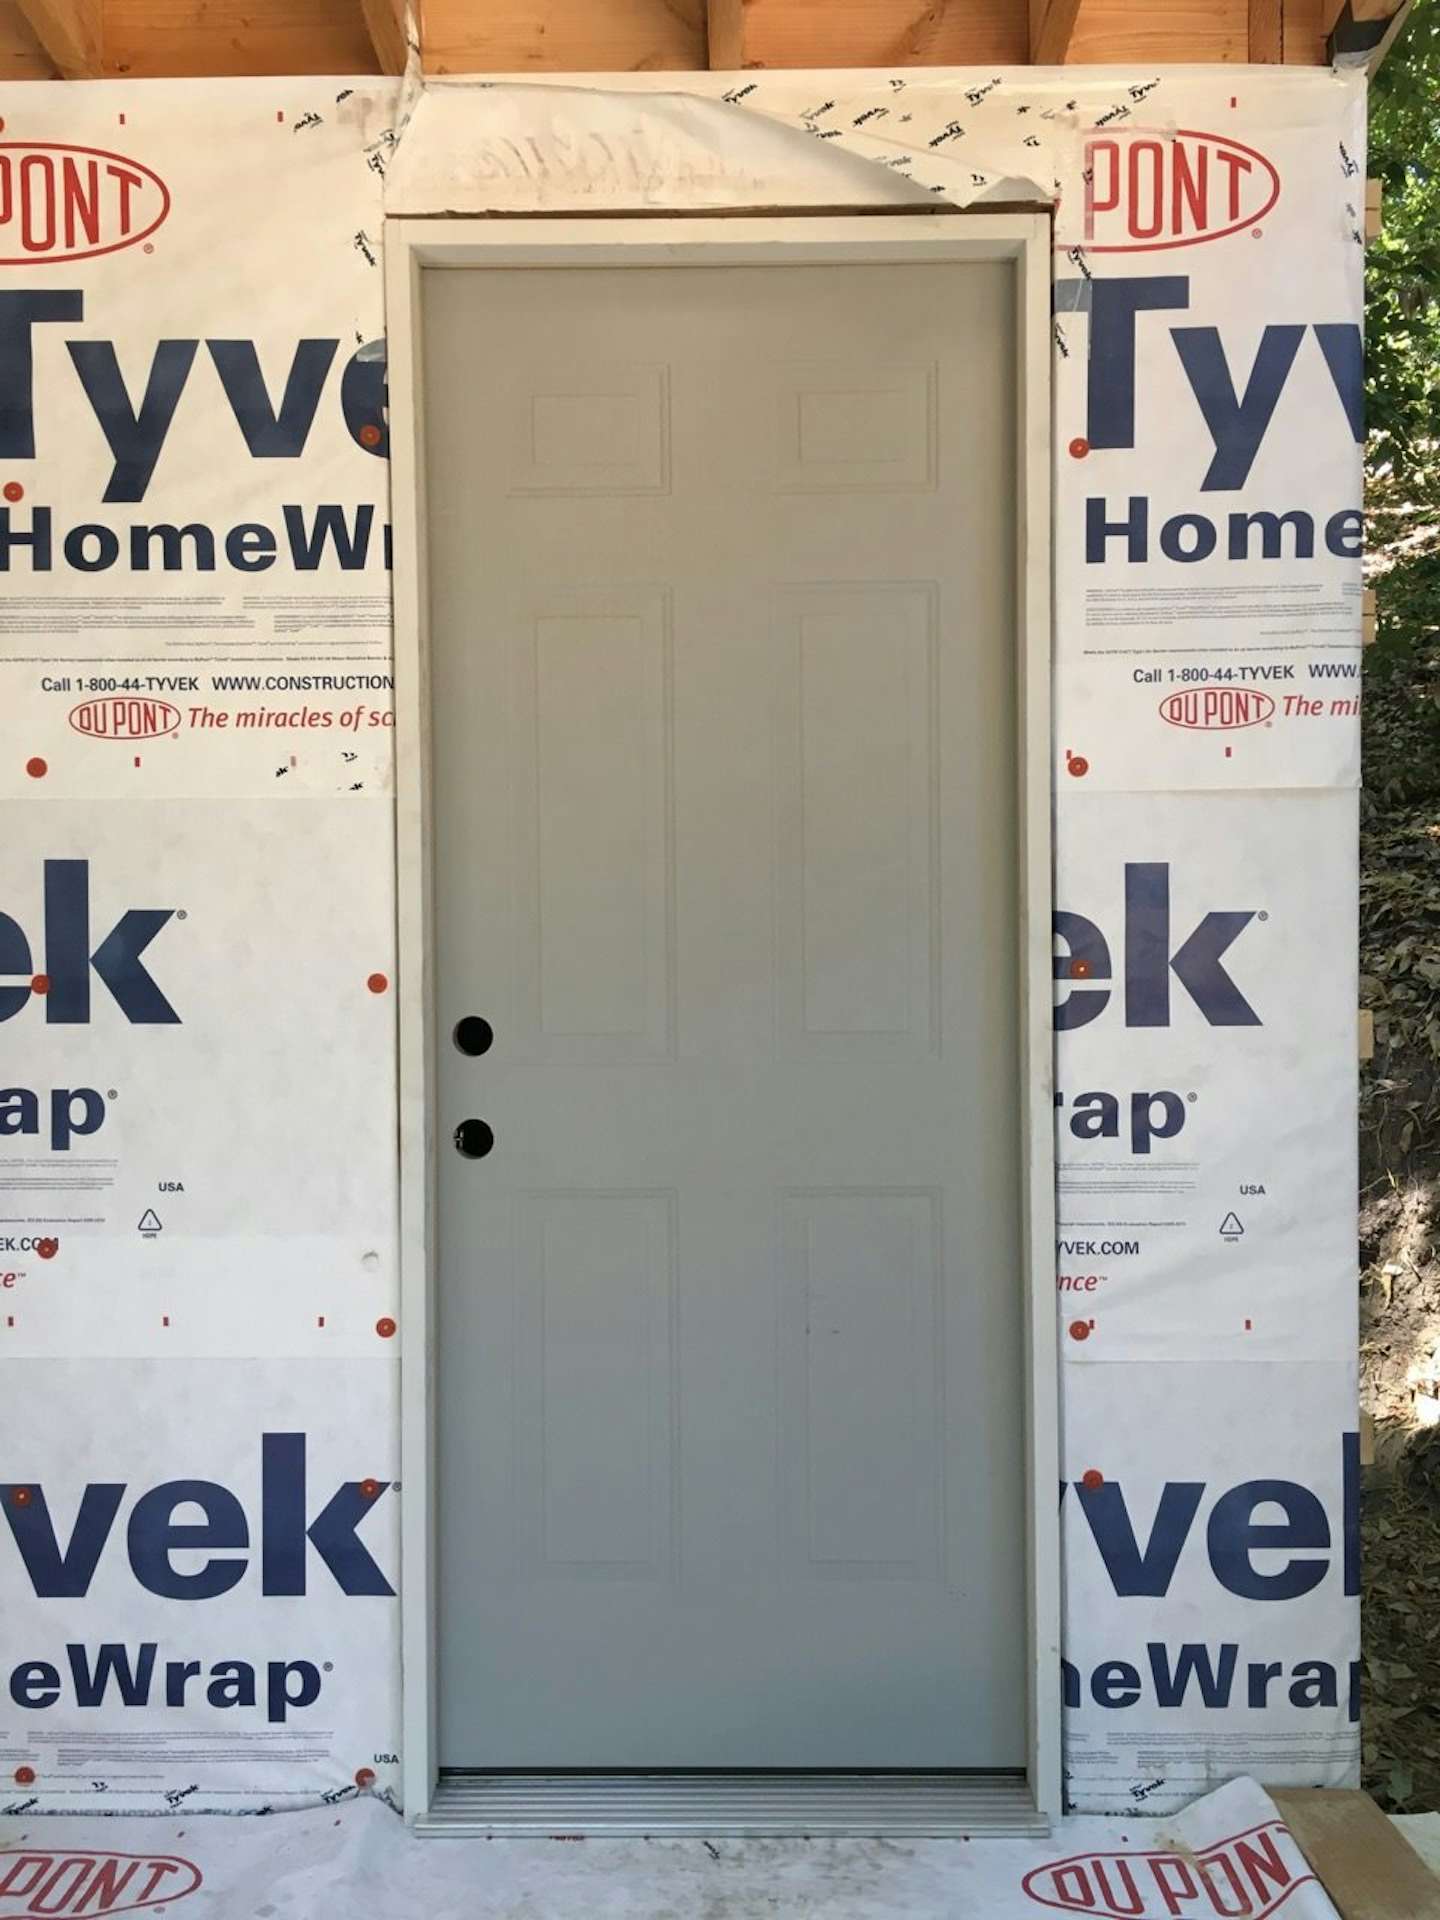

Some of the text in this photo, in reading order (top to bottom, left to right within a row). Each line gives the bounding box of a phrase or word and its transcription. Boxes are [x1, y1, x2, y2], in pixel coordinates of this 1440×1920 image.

[0, 504, 393, 572] HomeW
[1133, 668, 1162, 683] Call
[1168, 666, 1295, 682] 1-800-44-TYVEK
[41, 675, 394, 692] Call 1-800-44-TYVEK WWW.CONSTRUCTION
[1282, 695, 1323, 716] The
[188, 708, 229, 728] The
[236, 706, 332, 728] miracles
[339, 705, 366, 732] of
[158, 1182, 184, 1192] USA
[1239, 1184, 1266, 1196] USA
[374, 1754, 400, 1764] USA
